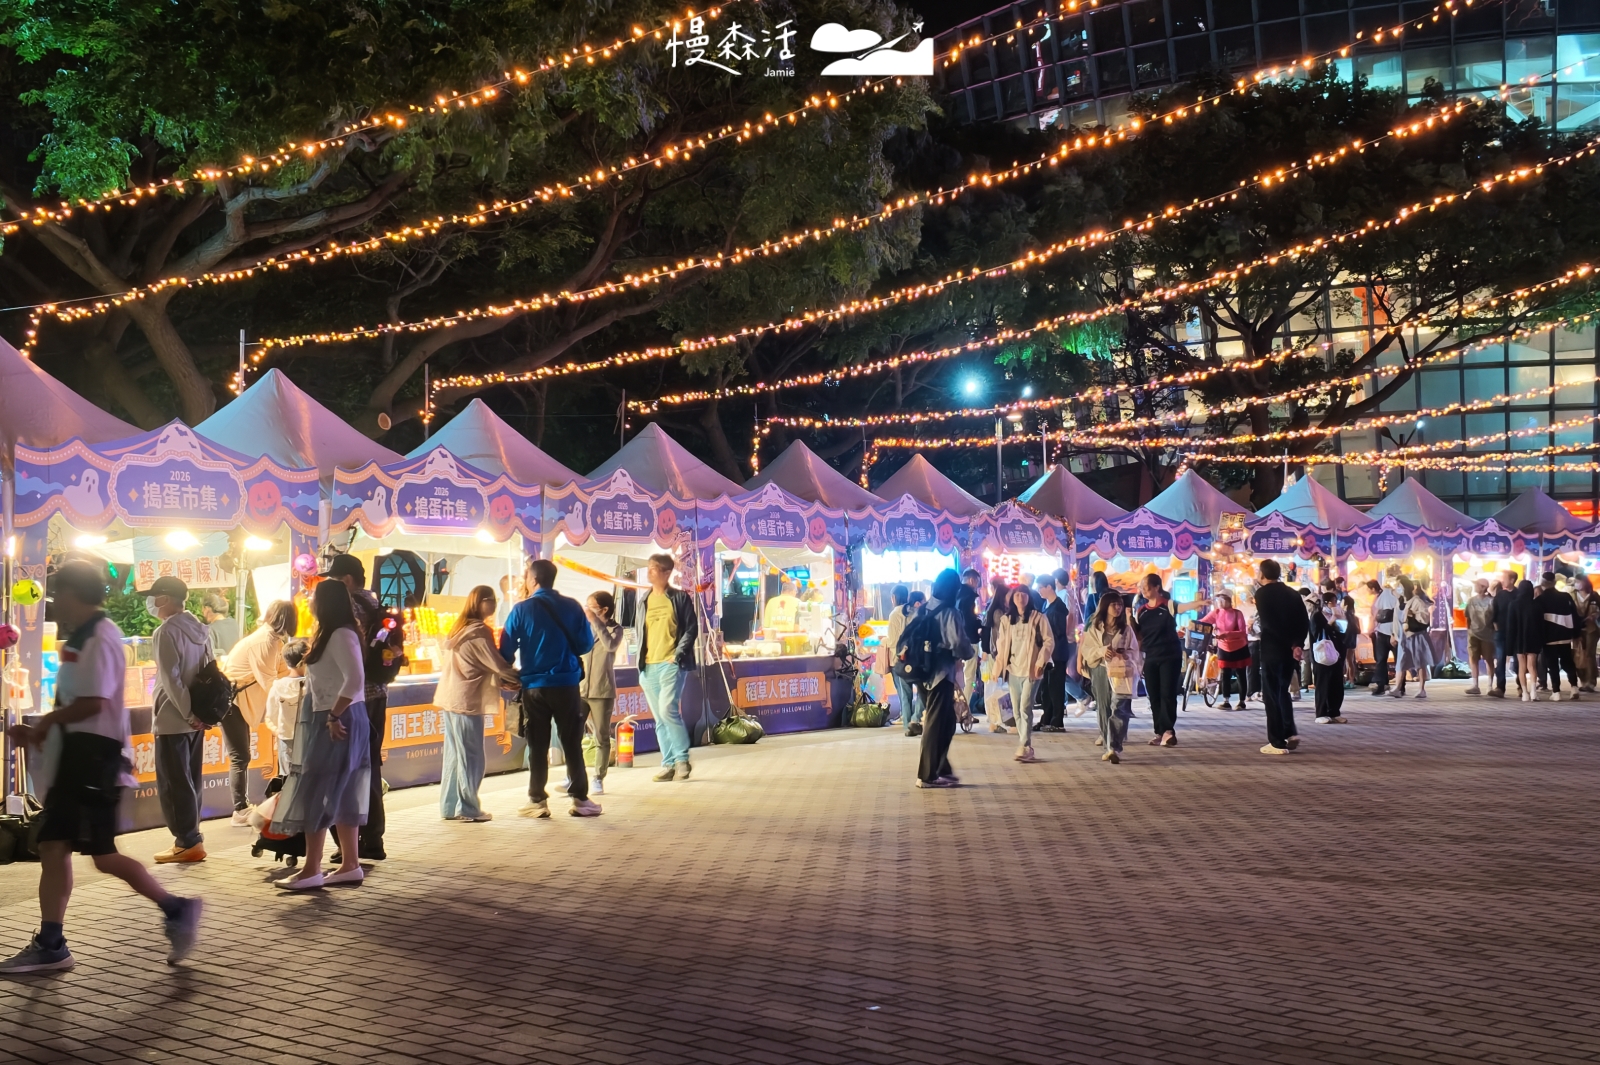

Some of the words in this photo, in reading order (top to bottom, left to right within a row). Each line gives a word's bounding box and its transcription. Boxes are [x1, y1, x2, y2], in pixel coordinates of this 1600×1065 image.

[170, 470, 191, 482] 2026
[142, 480, 218, 512] 搗蛋市集
[433, 486, 449, 497] 2026
[414, 496, 469, 522] 搗蛋市集
[603, 510, 643, 532] 搗蛋市集
[757, 518, 796, 538] 搗蛋市集
[1128, 536, 1163, 549] 搗蛋市集
[745, 676, 819, 702] 稻草人甘蔗煎餃
[781, 704, 812, 714] HALLOWEEN
[406, 746, 438, 760] TAOYUAN
